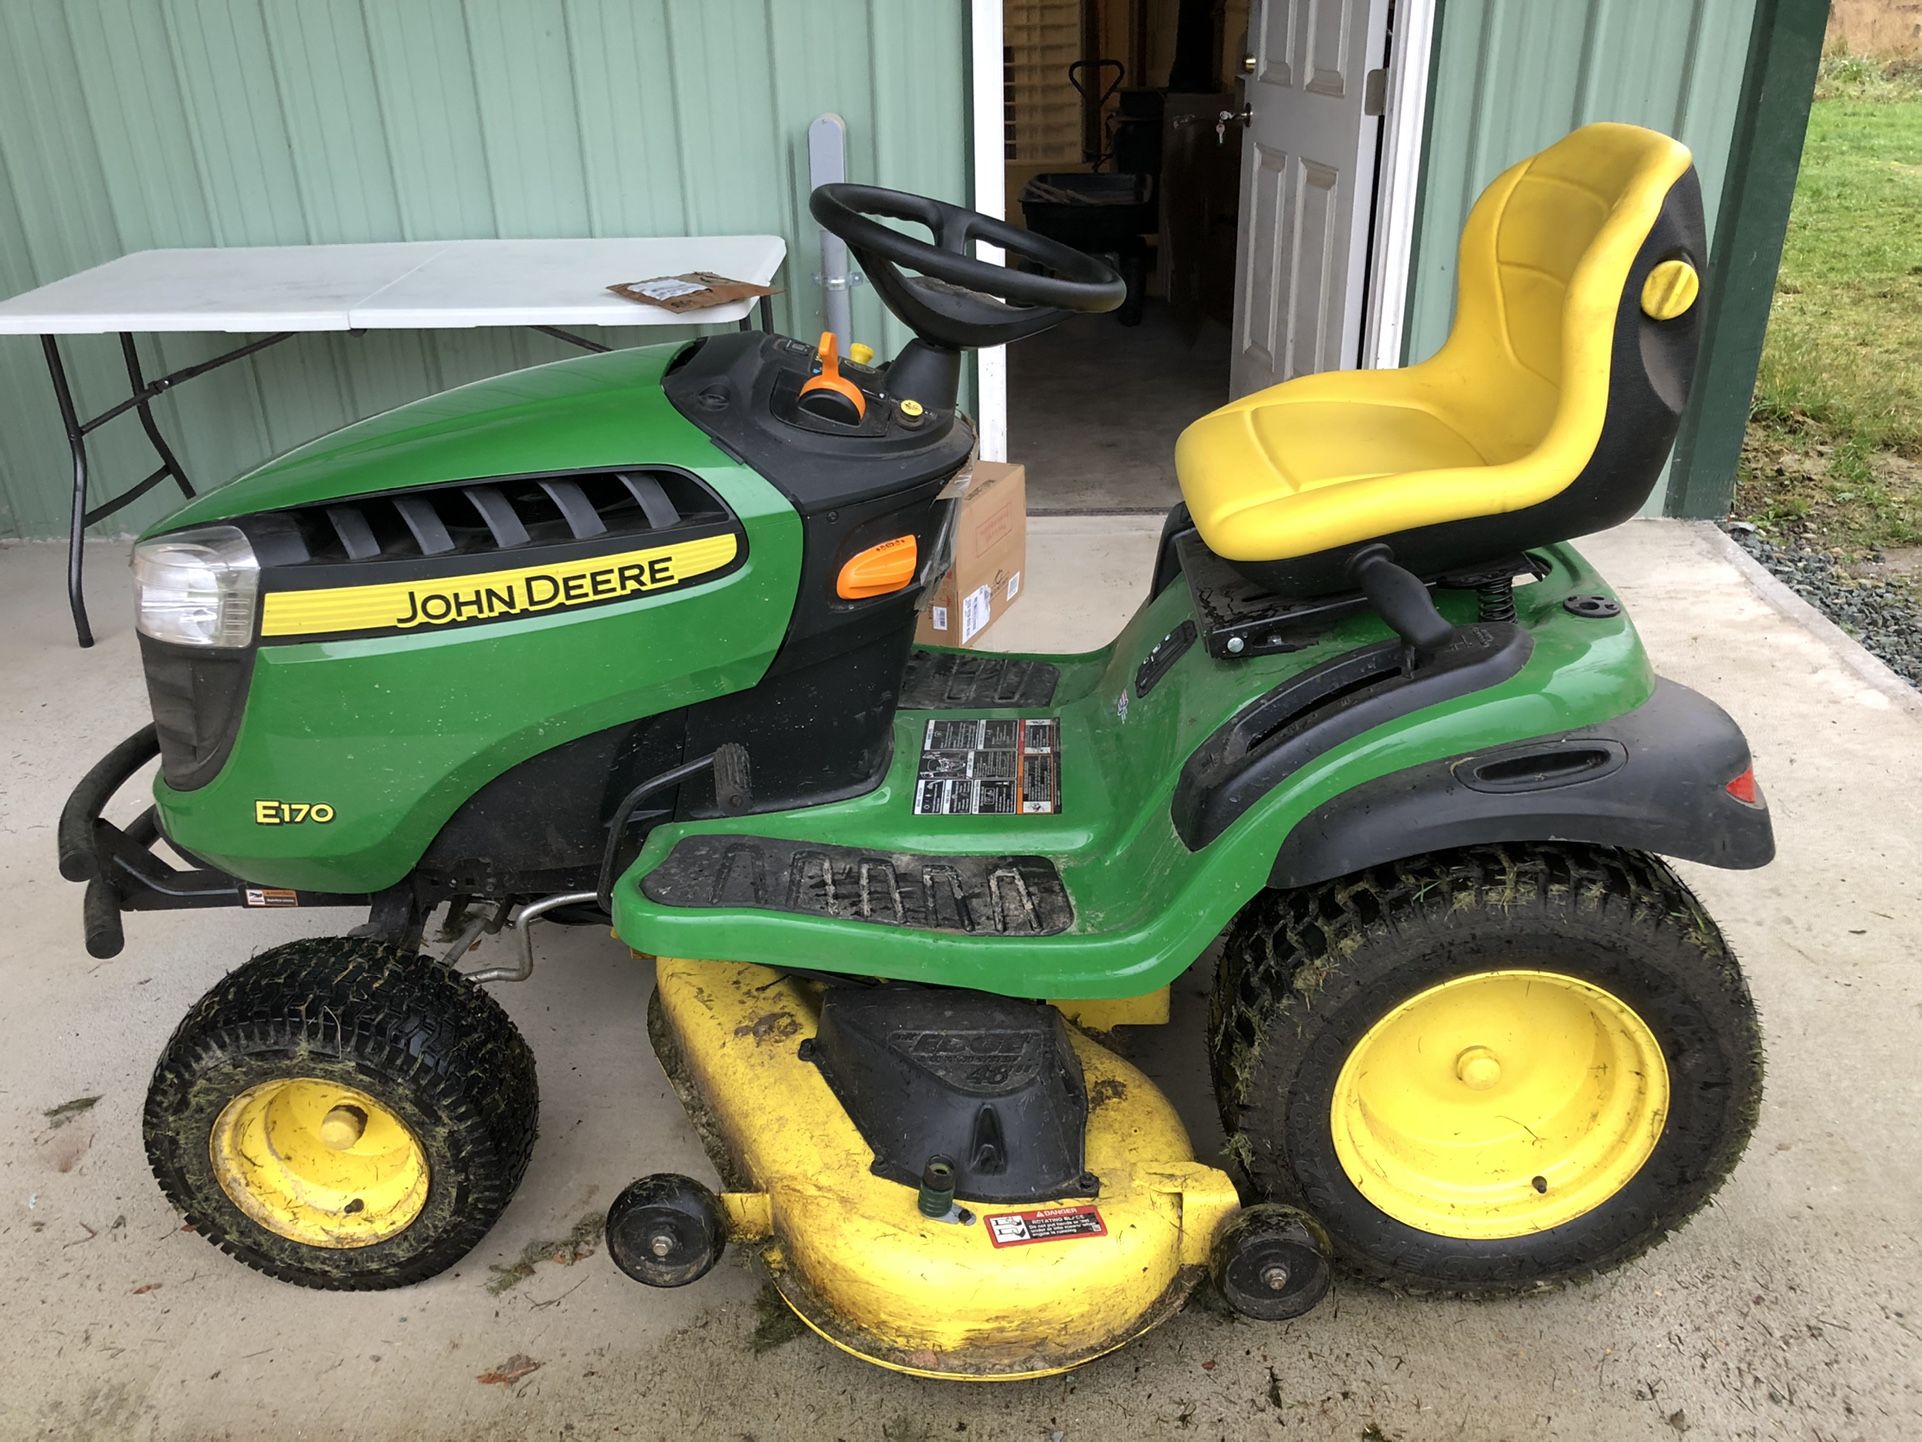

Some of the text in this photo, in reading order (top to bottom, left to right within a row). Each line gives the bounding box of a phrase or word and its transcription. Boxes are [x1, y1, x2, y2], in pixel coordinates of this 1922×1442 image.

[397, 557, 675, 623] JOHN DEERE
[254, 800, 335, 825] E170
[1044, 1208, 1077, 1216] DANGER
